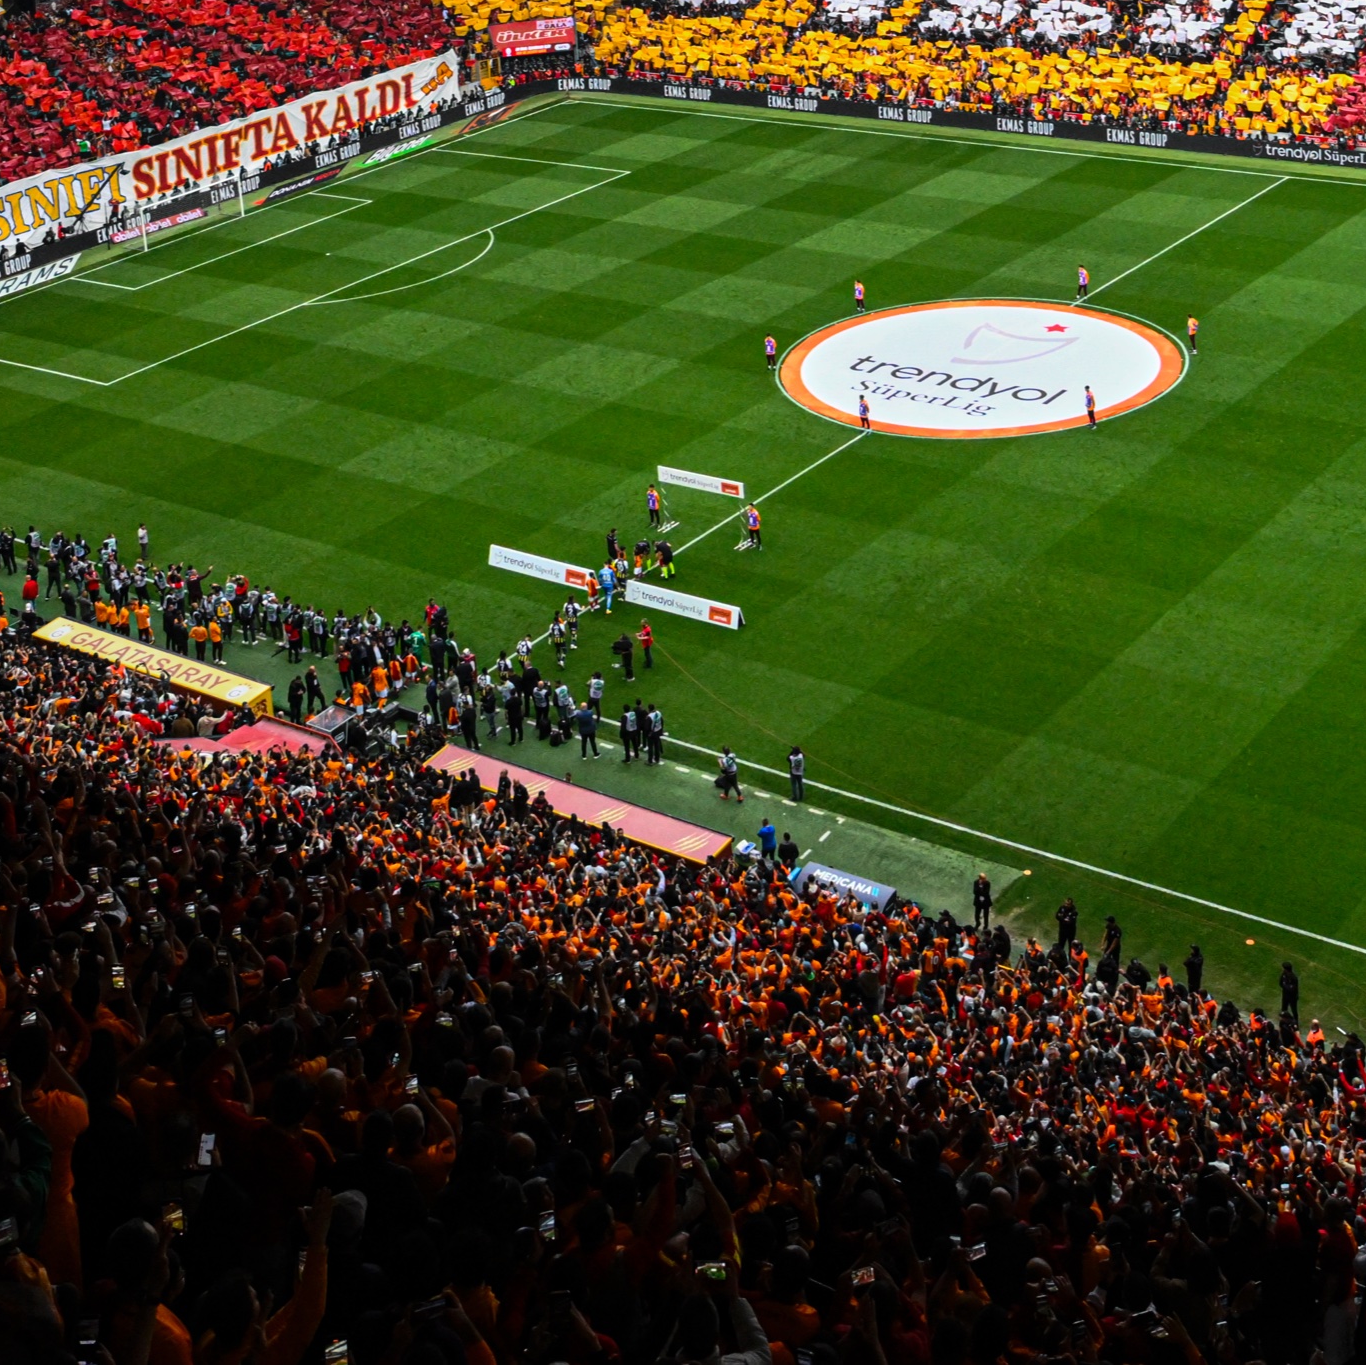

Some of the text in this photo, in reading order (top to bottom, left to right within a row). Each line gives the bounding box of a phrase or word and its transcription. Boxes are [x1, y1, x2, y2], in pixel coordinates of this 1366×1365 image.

[496, 29, 567, 44] ÜLKER
[588, 77, 612, 91] GROUP
[664, 84, 712, 101] EKMAS GROUP
[464, 100, 486, 117] EKMAS
[487, 92, 507, 110] GROUP
[768, 95, 818, 112] EKMAS GROUP
[878, 106, 932, 124] EKMAS GROUP
[131, 111, 299, 201] SINIFTA
[301, 72, 423, 142] KALDI
[398, 114, 443, 140] EKMAS GROUP
[996, 117, 1055, 136] EKMAS GROUP
[1106, 128, 1168, 147] EKMAS GROUP
[315, 142, 362, 169] EKMAS GROUP
[1265, 143, 1322, 162] trendyol
[3, 253, 33, 277] GROUP
[849, 354, 1068, 407] trendyol
[851, 377, 997, 417] SüperLig
[669, 473, 697, 484] trendyol
[503, 554, 535, 571] trendyol
[534, 563, 560, 579] SüperLig
[641, 591, 675, 607] trendyol
[675, 601, 704, 616] SüperLig
[69, 632, 231, 691] GALATASARAY
[812, 868, 873, 895] MEDICANA
